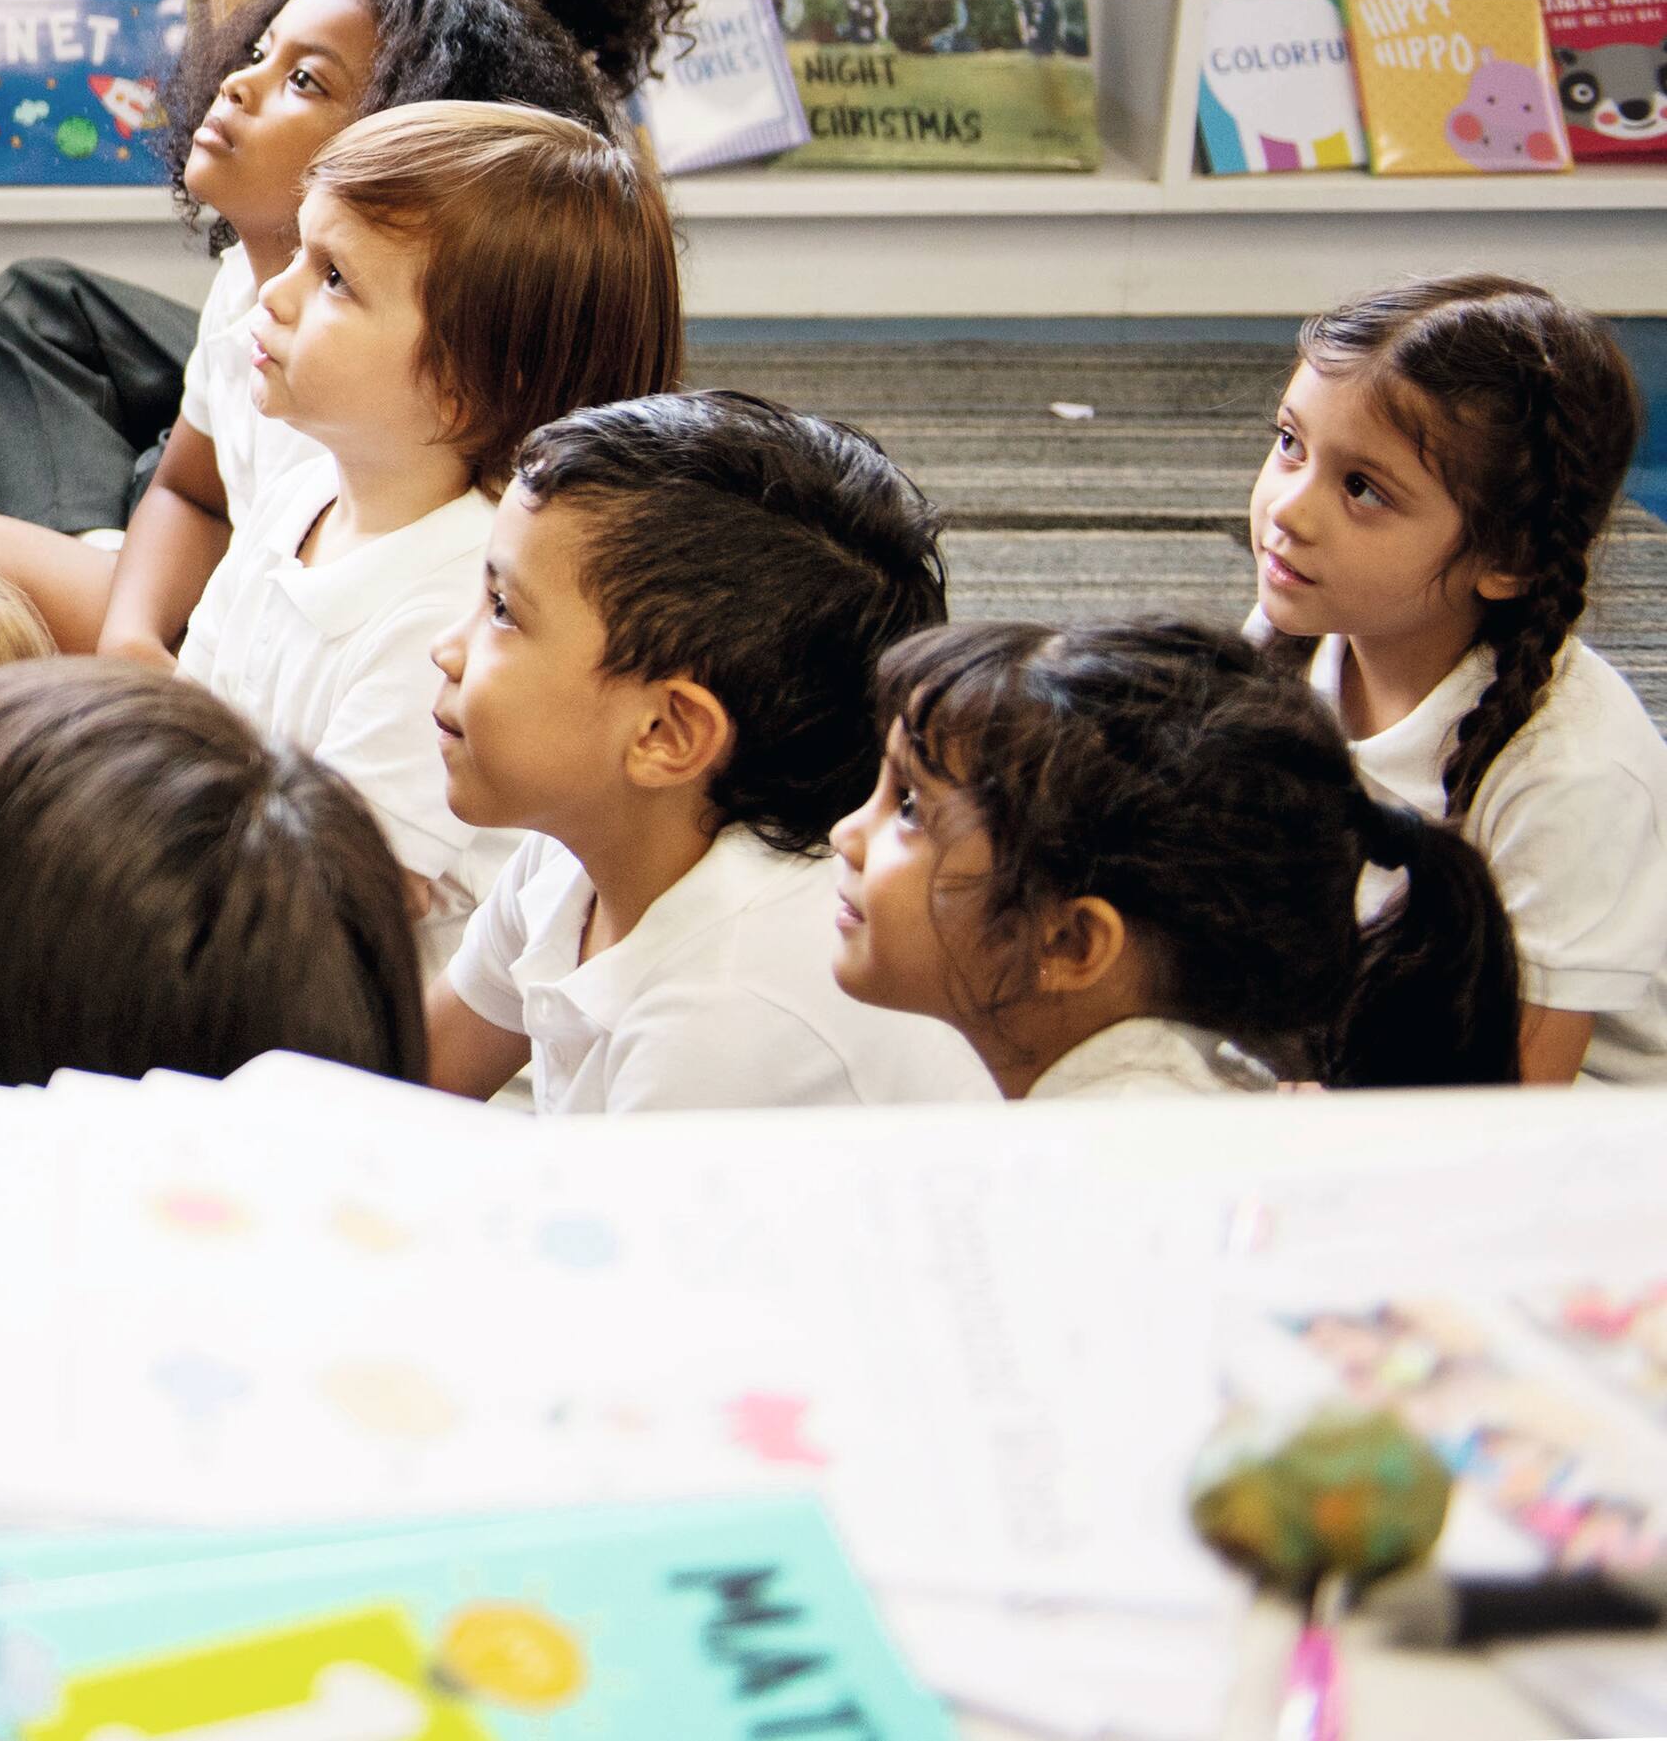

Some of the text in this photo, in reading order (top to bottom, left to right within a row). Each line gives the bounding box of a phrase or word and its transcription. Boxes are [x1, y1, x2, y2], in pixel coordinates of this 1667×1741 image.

[804, 56, 895, 87] NIGHT
[1211, 36, 1349, 77] COLORFU
[1374, 32, 1475, 75] HIPPO
[809, 102, 984, 144] CHRISTMAS
